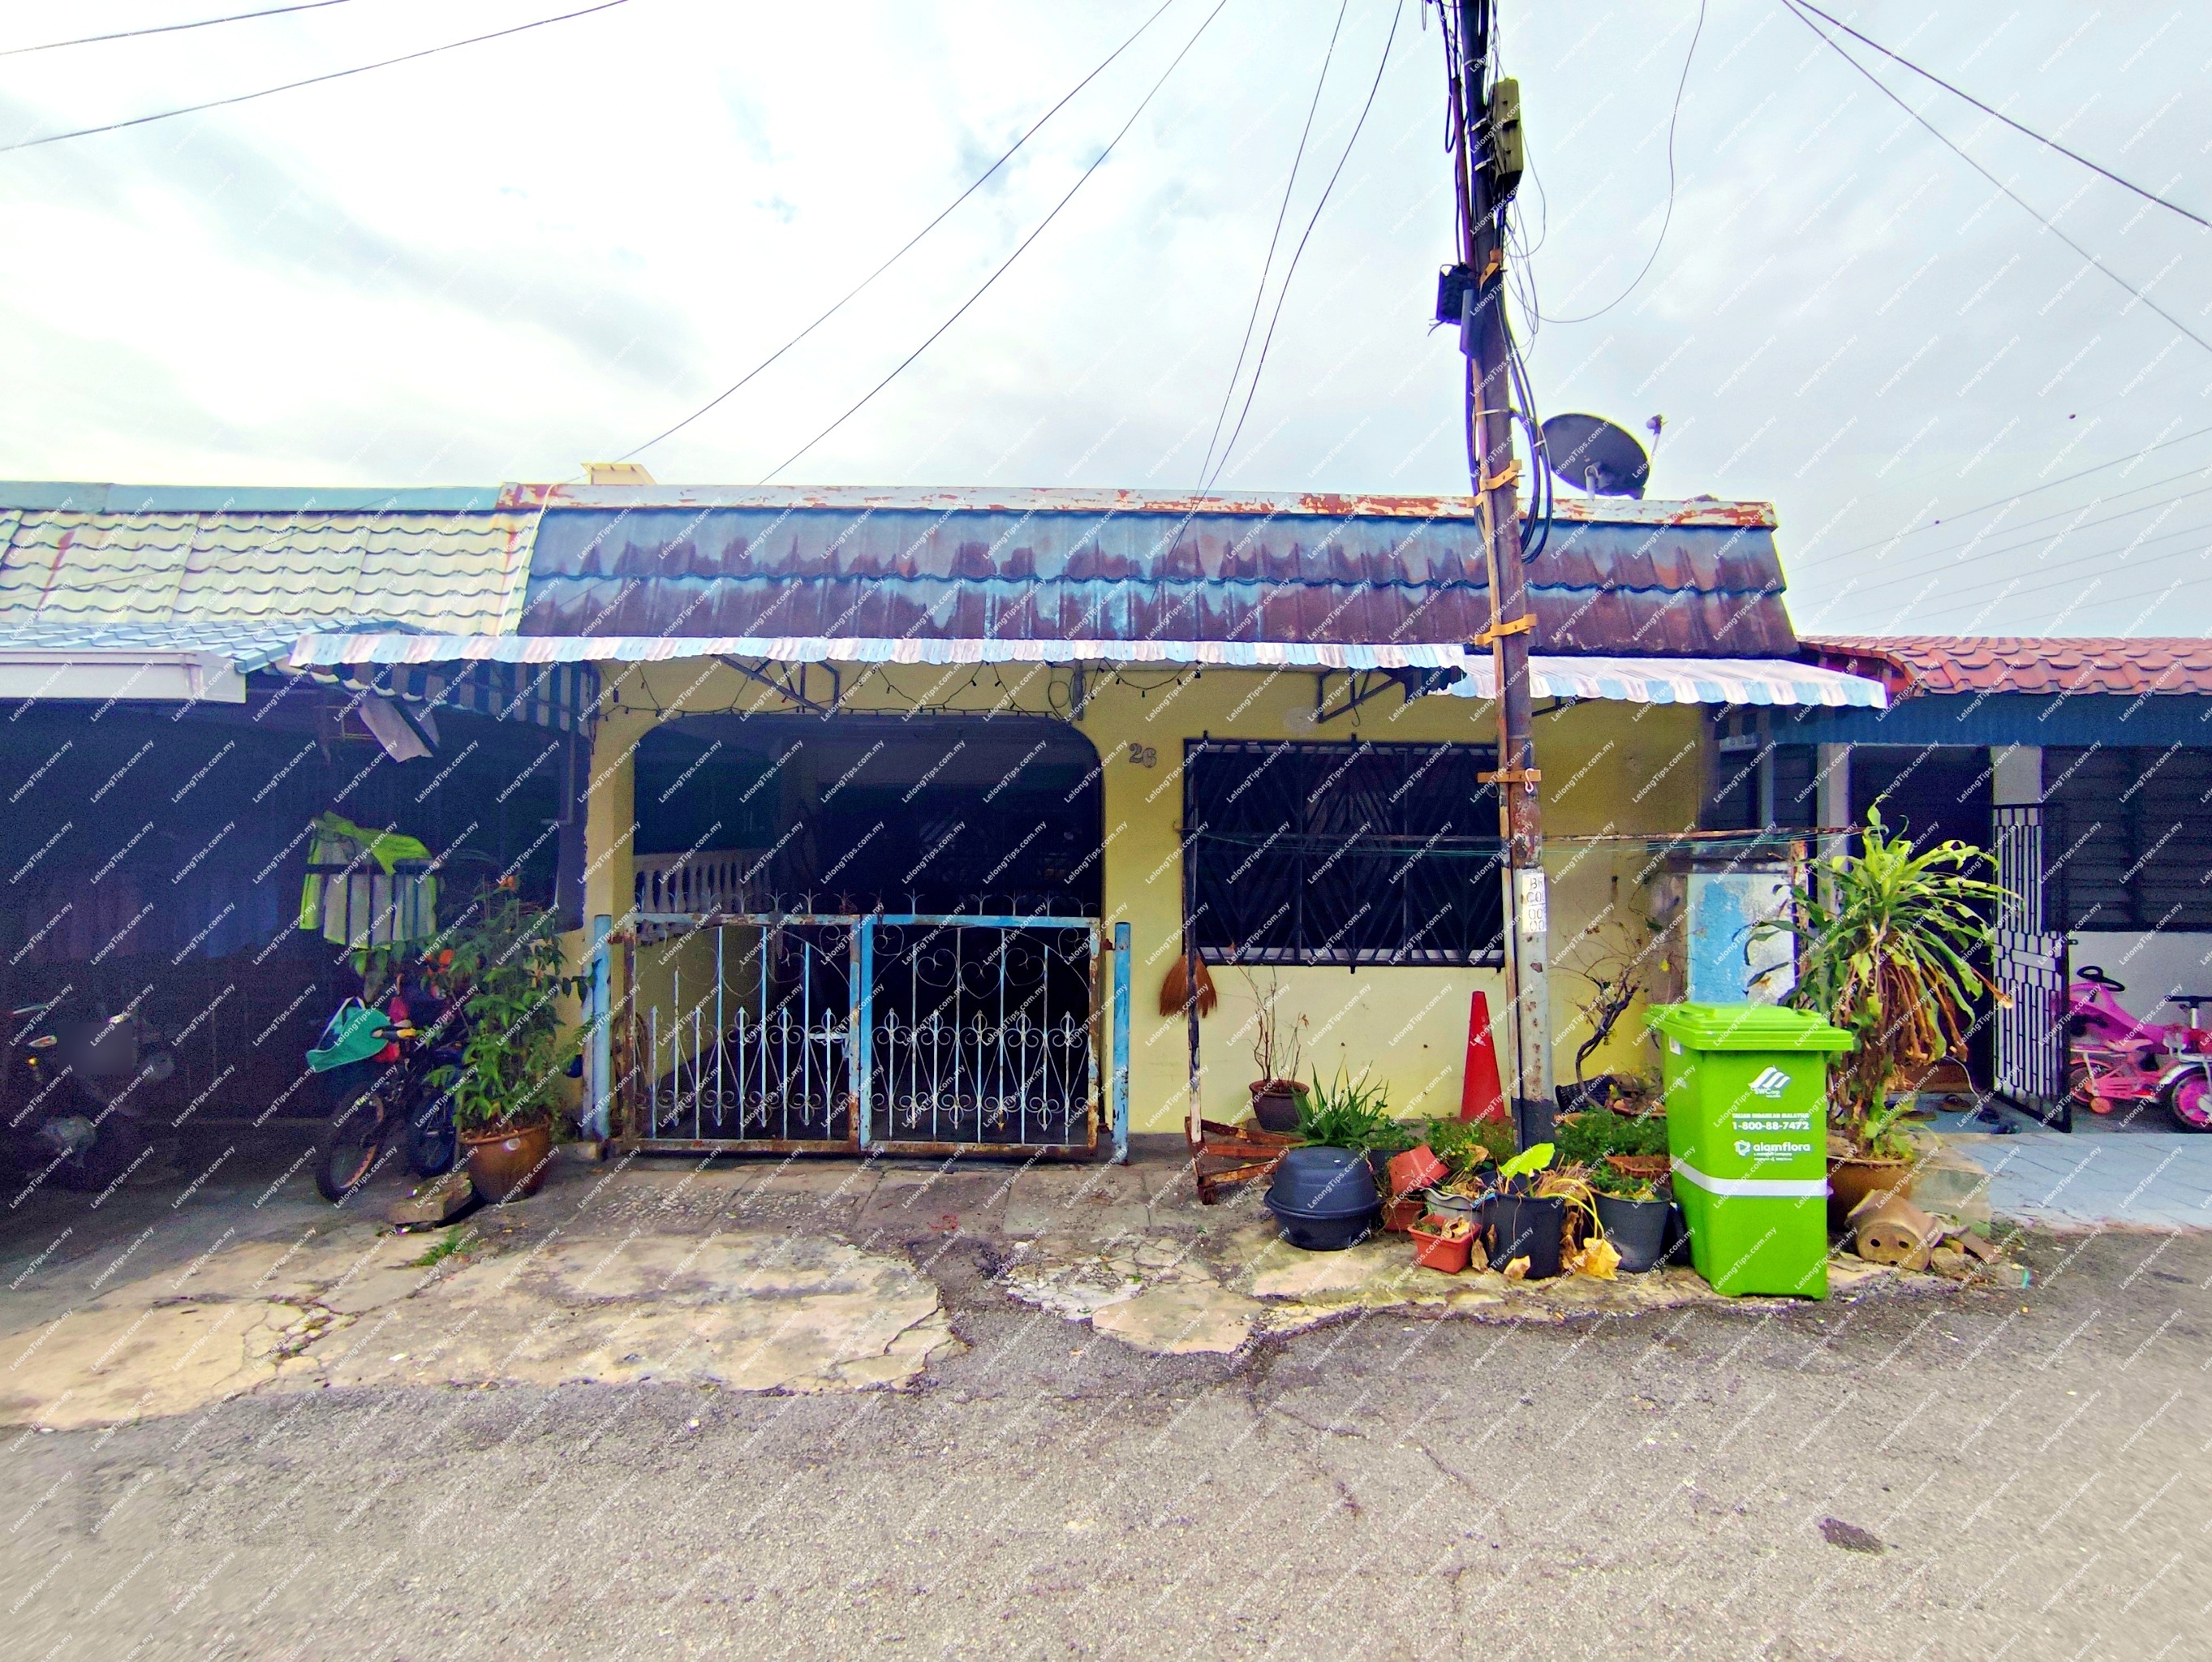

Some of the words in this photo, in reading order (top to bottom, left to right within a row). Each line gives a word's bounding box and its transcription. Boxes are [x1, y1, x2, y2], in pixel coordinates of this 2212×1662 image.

[1129, 743, 1157, 769] 26
[1732, 1121, 1810, 1130] 1-800-88-7472
[1753, 1141, 1811, 1152] alamflora
